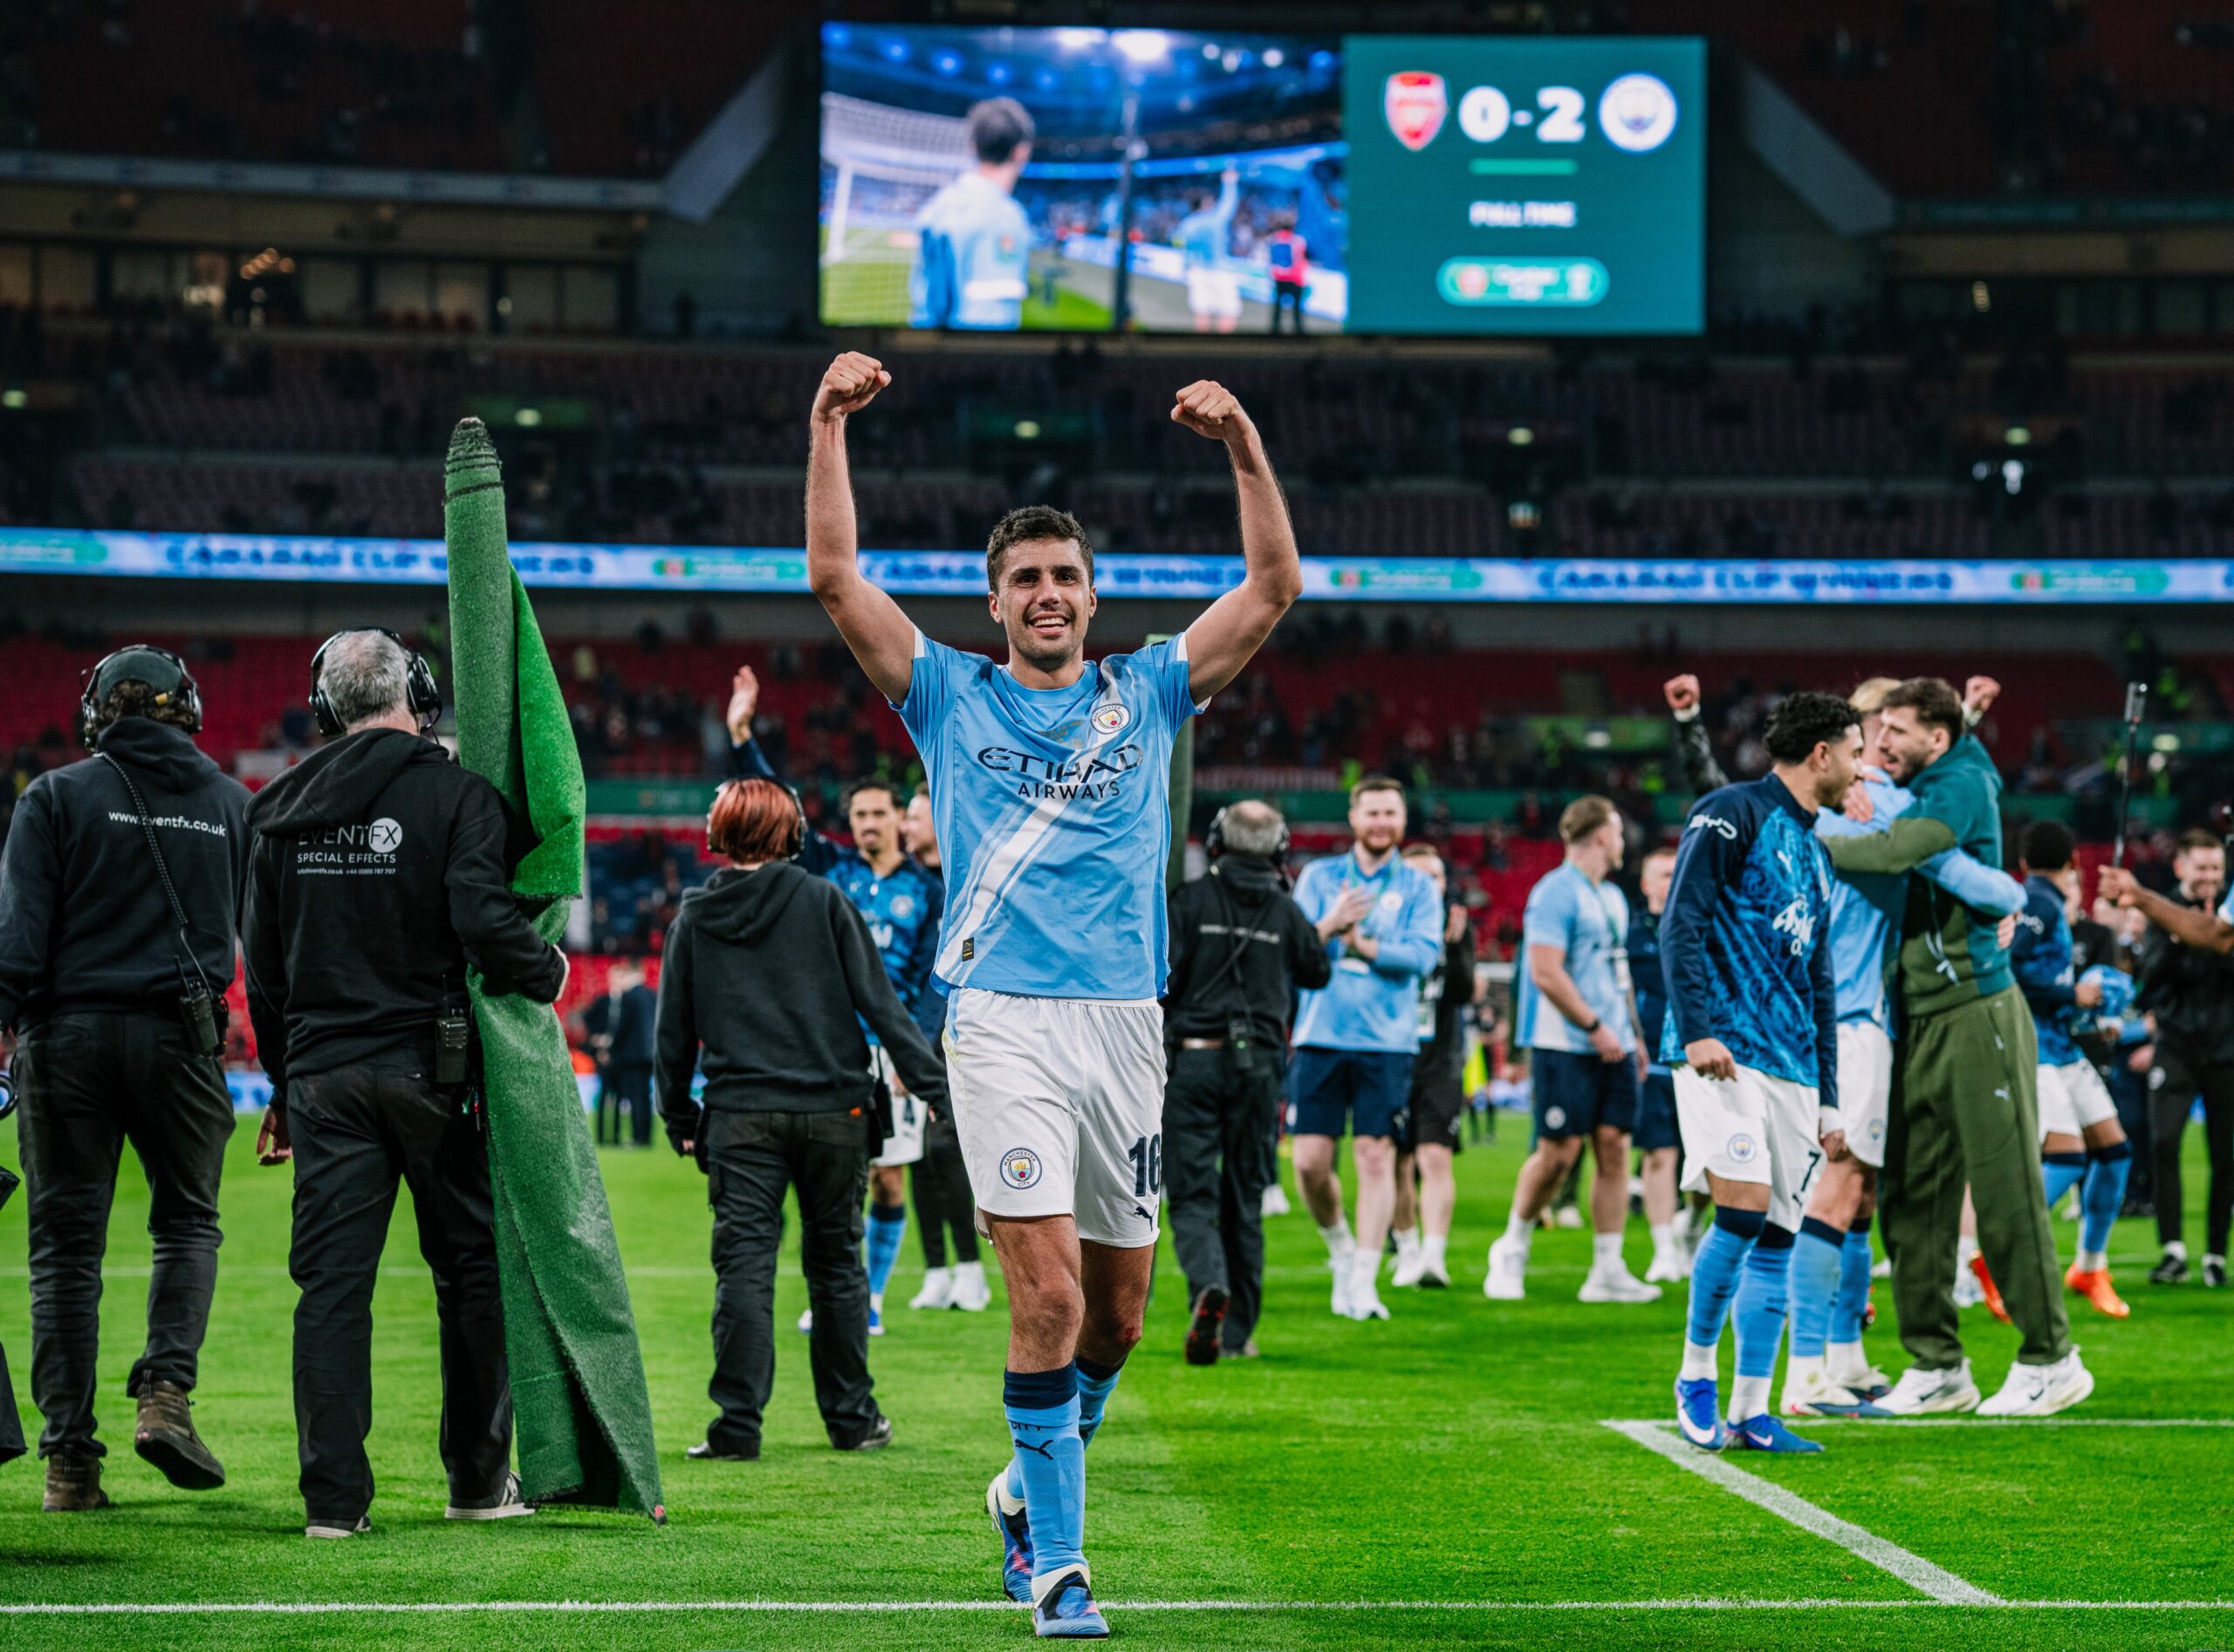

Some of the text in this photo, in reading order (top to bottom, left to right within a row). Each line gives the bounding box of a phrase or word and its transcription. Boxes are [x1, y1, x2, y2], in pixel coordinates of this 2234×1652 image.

[977, 744, 1143, 783] ETIHAD
[1018, 781, 1120, 799] AIRWAYS
[297, 852, 396, 864] SPECIAL EFFECTS
[1004, 1150, 1037, 1167] MANCHESTER
[1128, 1133, 1161, 1196] 16
[1800, 1150, 1821, 1192] 7
